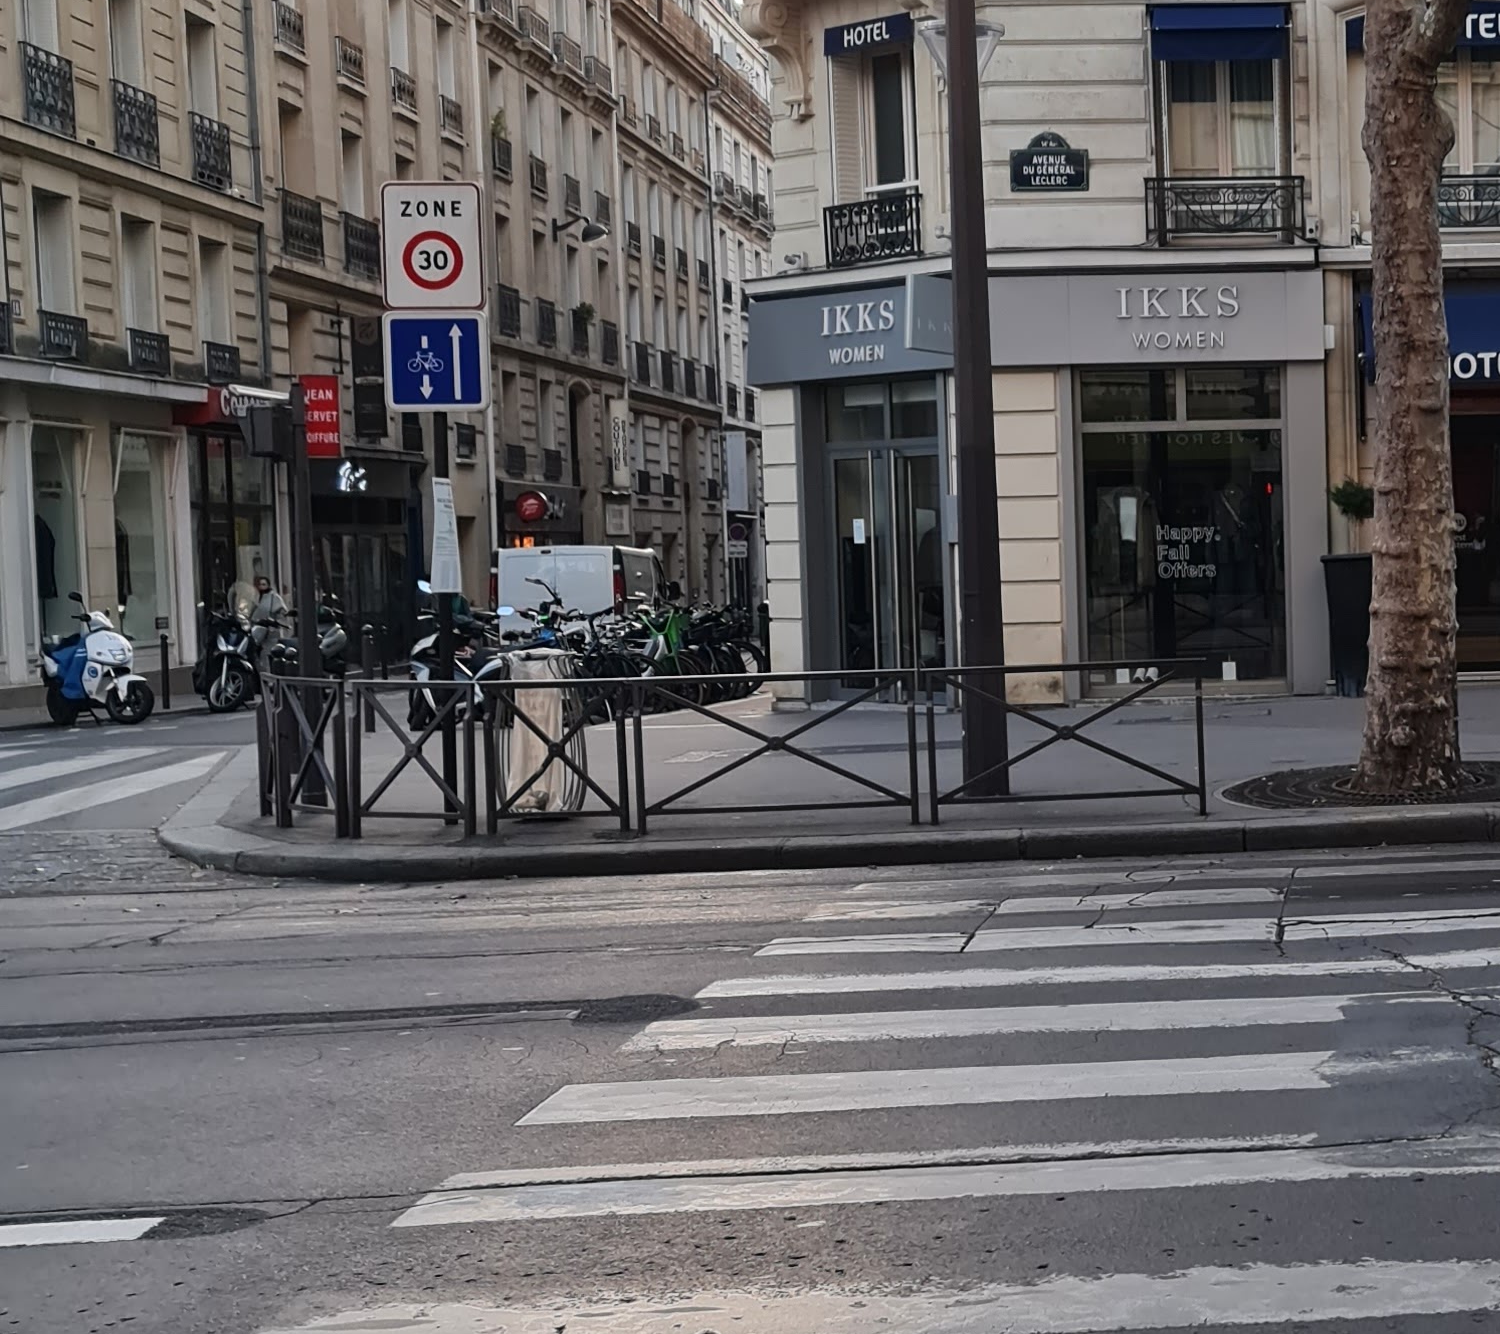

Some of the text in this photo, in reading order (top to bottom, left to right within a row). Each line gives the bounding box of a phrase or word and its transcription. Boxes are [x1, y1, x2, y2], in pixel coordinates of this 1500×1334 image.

[843, 20, 890, 48] HOTEL
[1032, 154, 1066, 164] AVENUE
[1023, 164, 1076, 175] DU GÉNÉRAL
[1031, 175, 1068, 185] LECLERC
[400, 200, 463, 217] ZONE
[418, 250, 449, 270] 30
[1115, 285, 1241, 319] IKKS
[820, 299, 896, 337] IKKS
[1132, 331, 1225, 349] WOMEN
[829, 344, 885, 365] WOMEN
[305, 411, 338, 423] ERVET
[306, 432, 340, 444] OIFFURE
[1157, 544, 1190, 561] Fall
[1158, 561, 1217, 579] Offers
